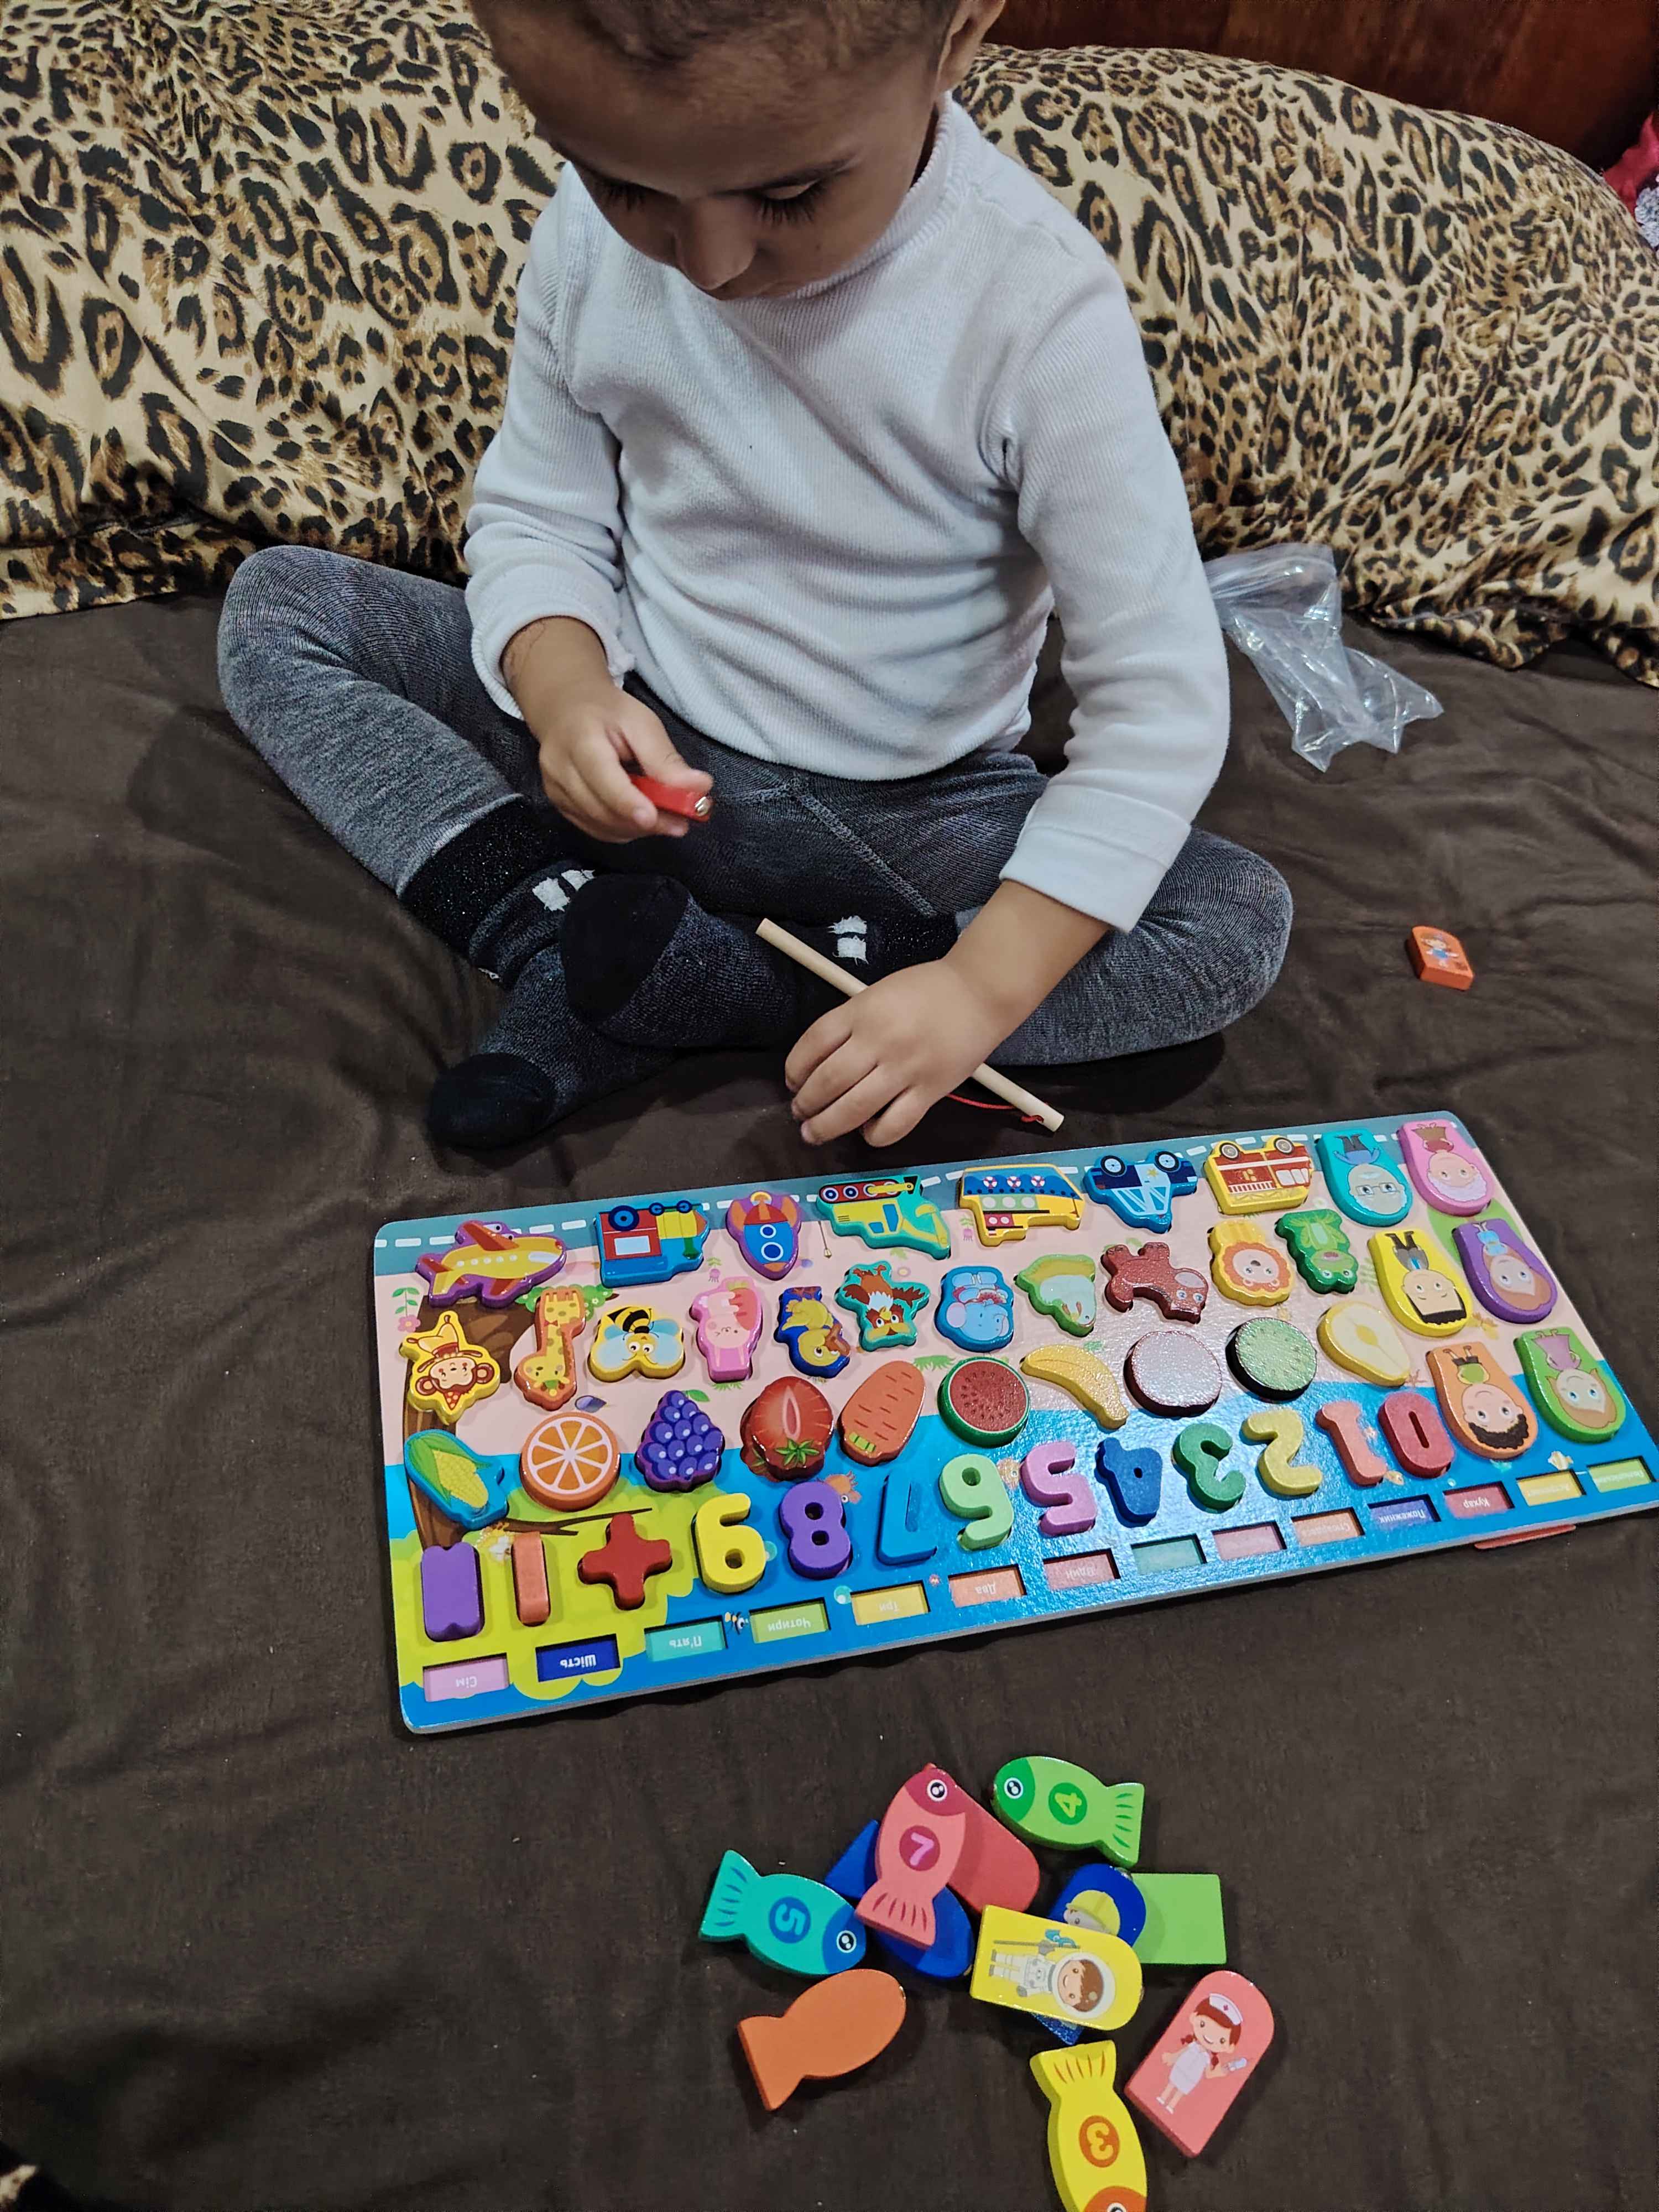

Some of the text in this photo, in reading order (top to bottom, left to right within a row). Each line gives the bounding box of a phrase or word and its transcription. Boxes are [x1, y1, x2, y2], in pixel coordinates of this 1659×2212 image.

[1315, 1400, 1387, 1486] 1
[1378, 1391, 1455, 1479] 0
[1172, 1423, 1246, 1514] 3
[1241, 1408, 1323, 1498] 2
[1021, 1441, 1098, 1537] 5
[1096, 1437, 1163, 1527] 4
[1378, 1509, 1426, 1524] Пожежник
[1463, 1496, 1490, 1509] Кухар
[779, 1480, 852, 1579] 8
[876, 1473, 937, 1566] 7
[974, 1582, 997, 1595] Два
[879, 1599, 899, 1613] Три
[767, 1616, 811, 1632] Чотири
[669, 1635, 702, 1648] П'ять
[560, 1653, 597, 1670] Шість
[455, 1675, 478, 1689] Сім
[1055, 1790, 1082, 1818] 4
[909, 1833, 933, 1865] 7
[776, 1904, 807, 1936] 5
[1087, 2122, 1113, 2160] 3
